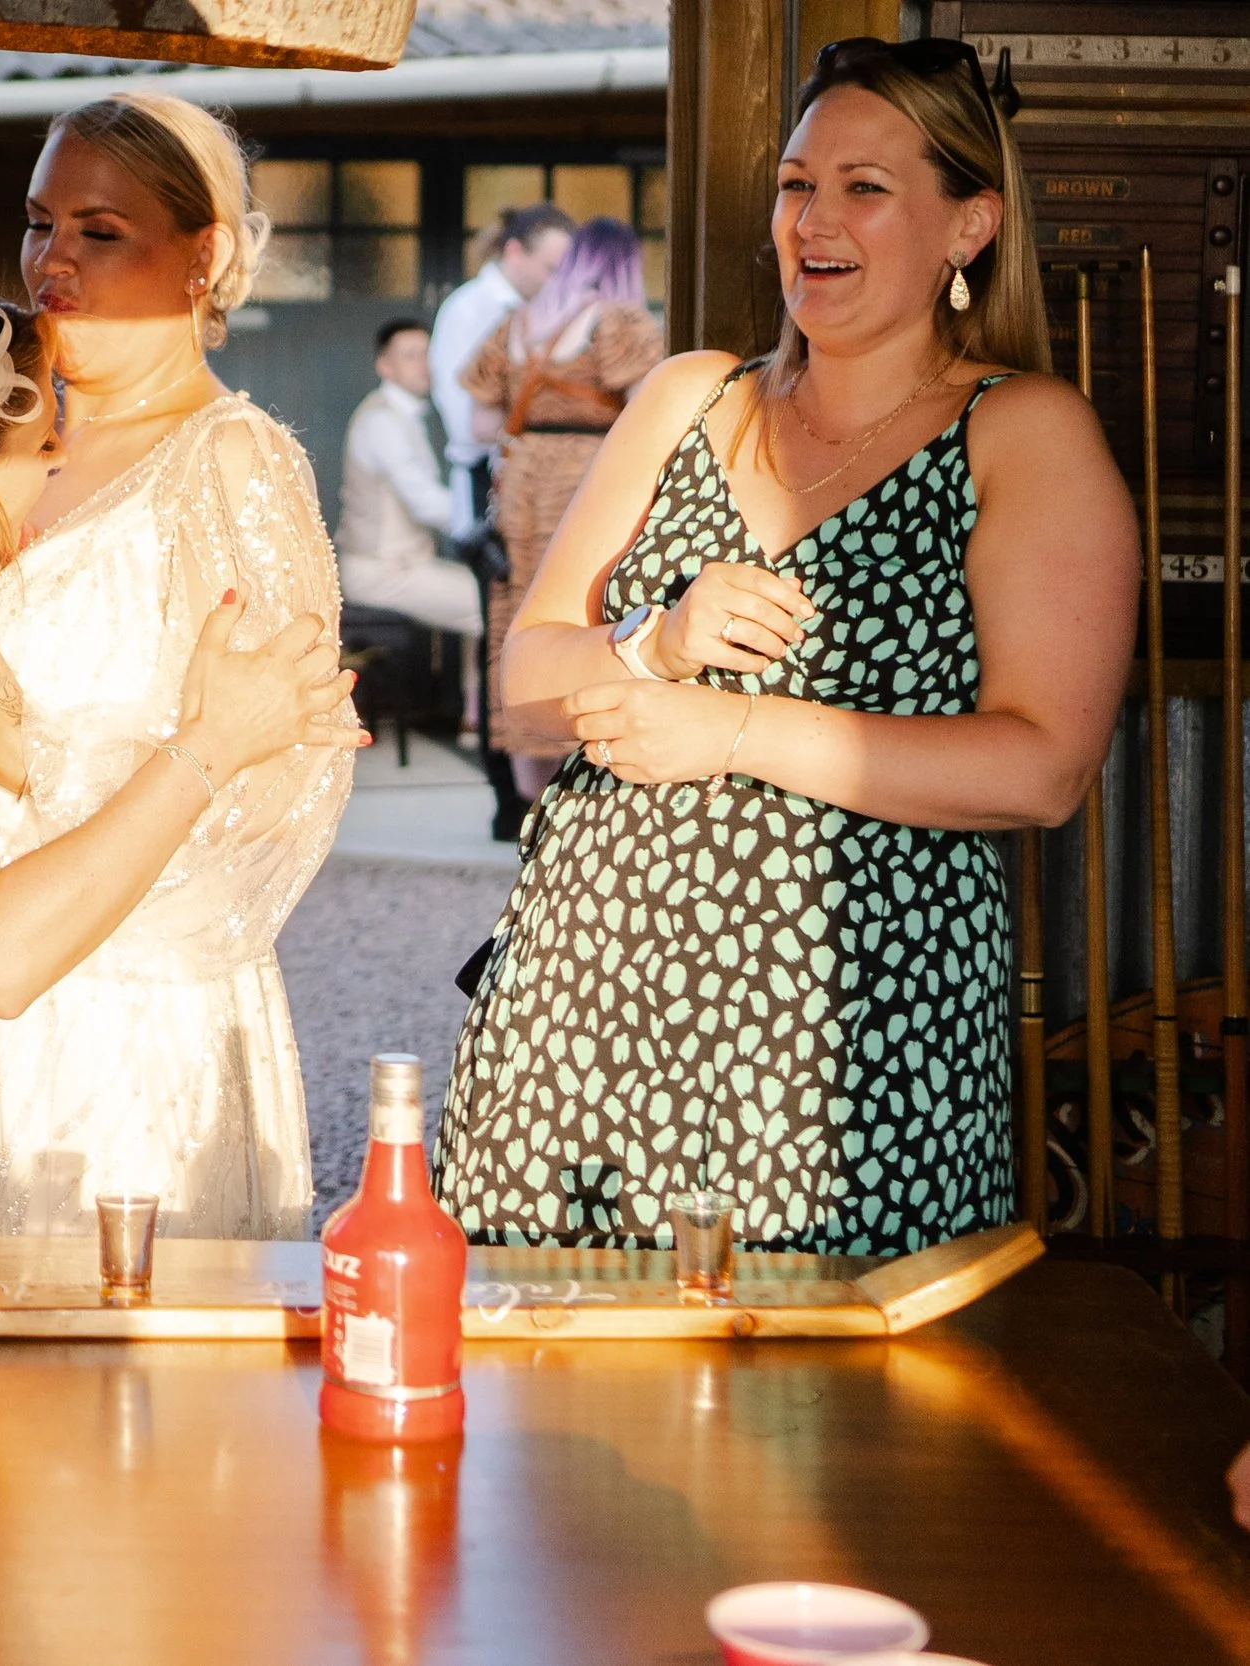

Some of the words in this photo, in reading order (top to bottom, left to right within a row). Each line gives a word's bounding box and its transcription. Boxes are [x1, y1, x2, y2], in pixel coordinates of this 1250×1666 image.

[977, 36, 994, 58] 0
[1023, 39, 1034, 60] 1
[1066, 39, 1083, 60] 2
[1112, 38, 1130, 61] 3
[1162, 38, 1184, 63] 4
[1211, 40, 1232, 64] 5
[1045, 178, 1114, 197] BROWN
[1057, 227, 1093, 244] RED
[1169, 555, 1209, 579] 45
